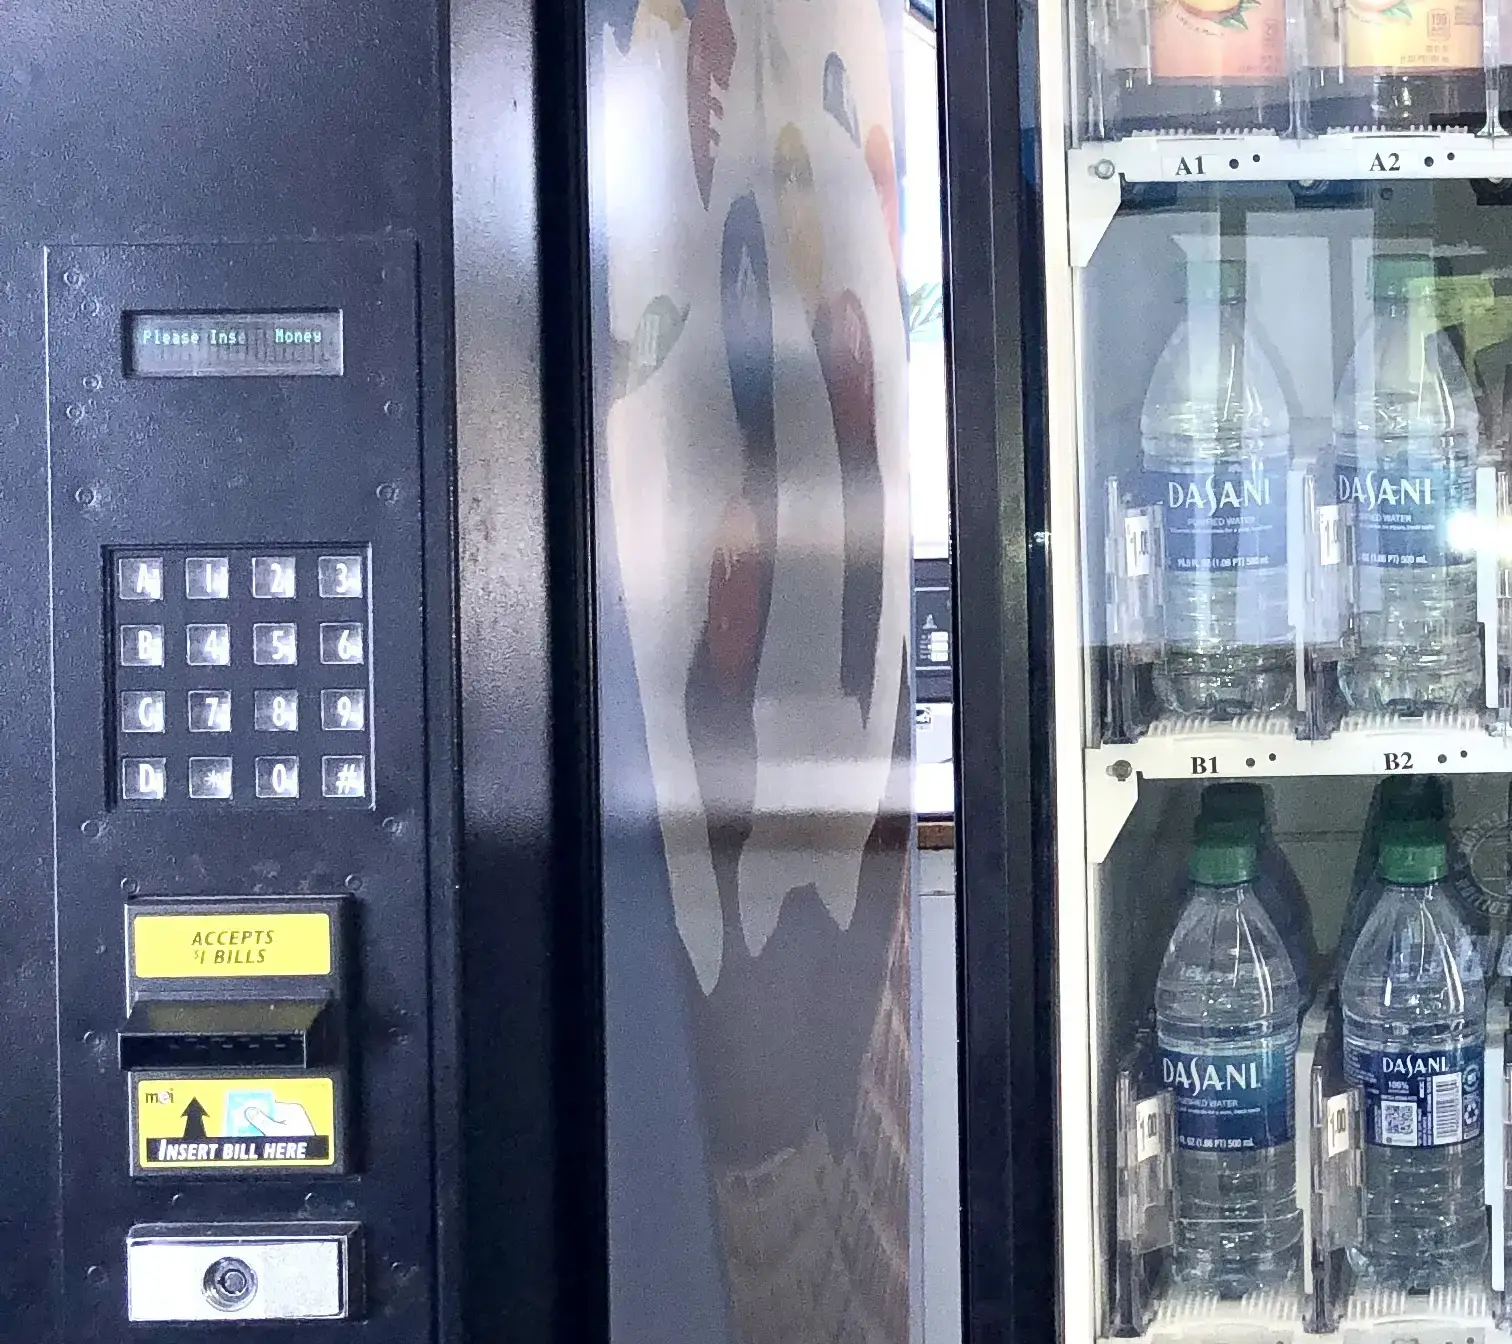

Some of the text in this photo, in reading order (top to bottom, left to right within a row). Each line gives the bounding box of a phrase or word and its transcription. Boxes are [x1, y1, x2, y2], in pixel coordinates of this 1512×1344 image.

[1175, 156, 1206, 175] A1
[1369, 152, 1401, 172] A2
[143, 328, 200, 346] Please
[275, 328, 322, 344] Money
[1168, 473, 1271, 517] DASANI
[1339, 470, 1435, 511] DASANI
[137, 562, 348, 593] A 1 2 3
[138, 629, 351, 660] B 4 5 6
[138, 696, 351, 727] C 7 8 9
[1191, 757, 1219, 774] B1
[1383, 752, 1413, 770] B2
[139, 763, 357, 794] D 0 #
[190, 929, 275, 946] ACCEPTS
[213, 949, 267, 965] BILLS
[1163, 1056, 1262, 1097] DASANI
[1382, 1054, 1450, 1078] DASANI
[158, 1139, 308, 1161] INSERT BILL HERE
